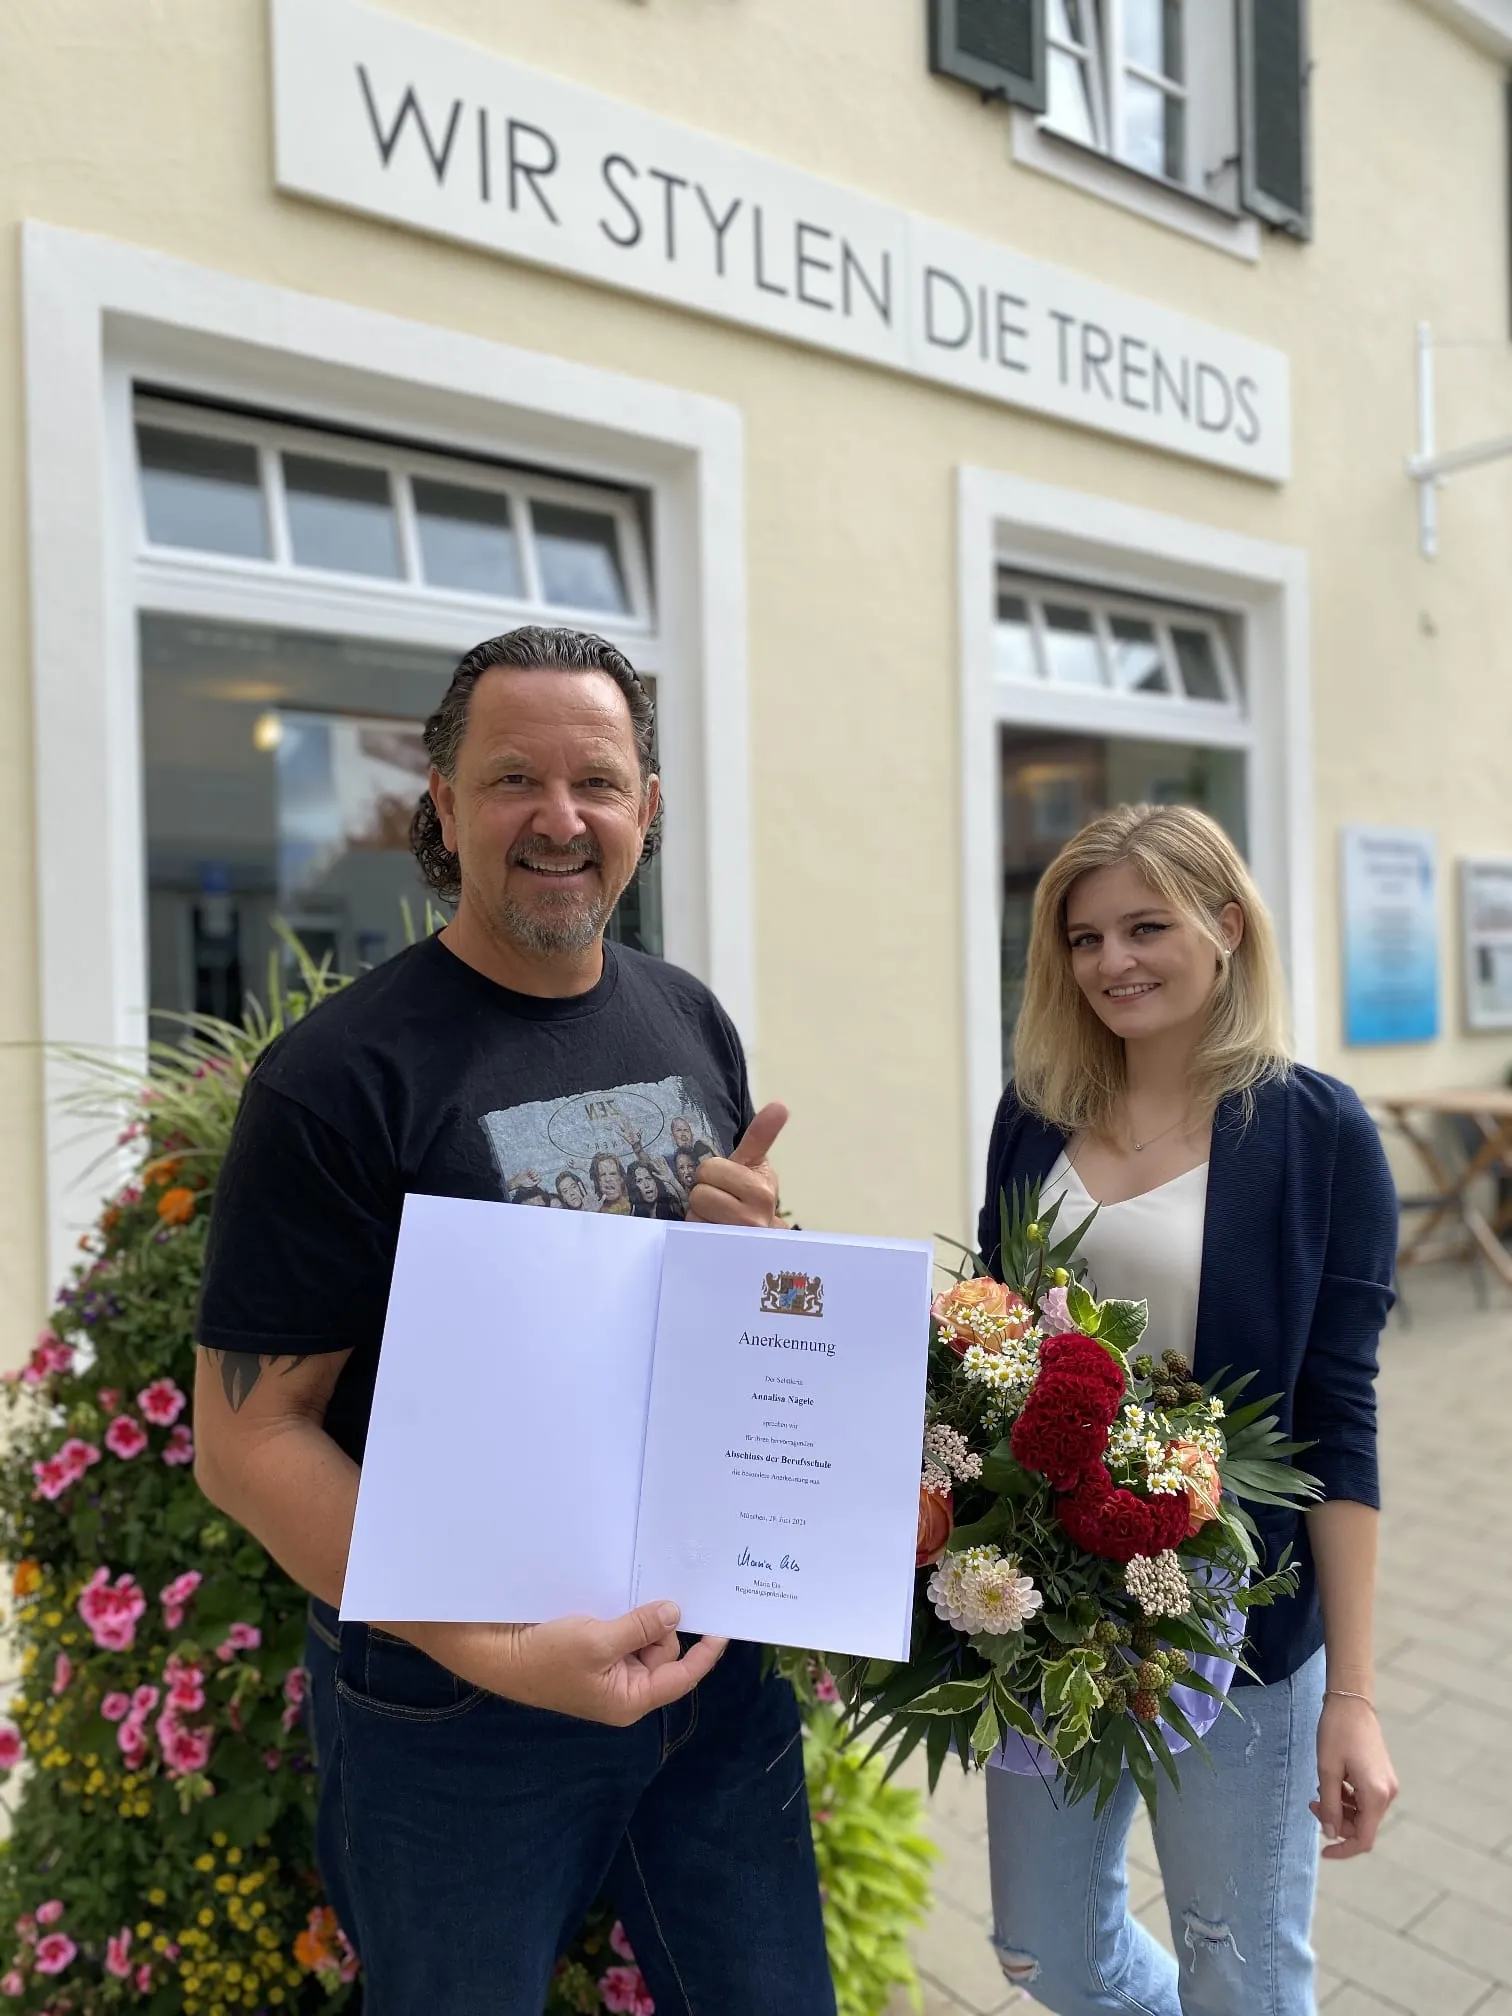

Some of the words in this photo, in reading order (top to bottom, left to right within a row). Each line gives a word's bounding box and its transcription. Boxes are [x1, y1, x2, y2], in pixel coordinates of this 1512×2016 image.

[357, 63, 561, 225] WIR
[599, 154, 893, 329] STYLEN
[922, 265, 1031, 373] DIE
[1049, 309, 1261, 445] TRENDS
[738, 1331, 836, 1357] Anerkennung
[752, 1392, 786, 1403] Annalisa
[788, 1395, 815, 1407] Nägele
[725, 1449, 764, 1461] Abschluss
[766, 1454, 779, 1463] der
[781, 1455, 832, 1469] Berufsschule
